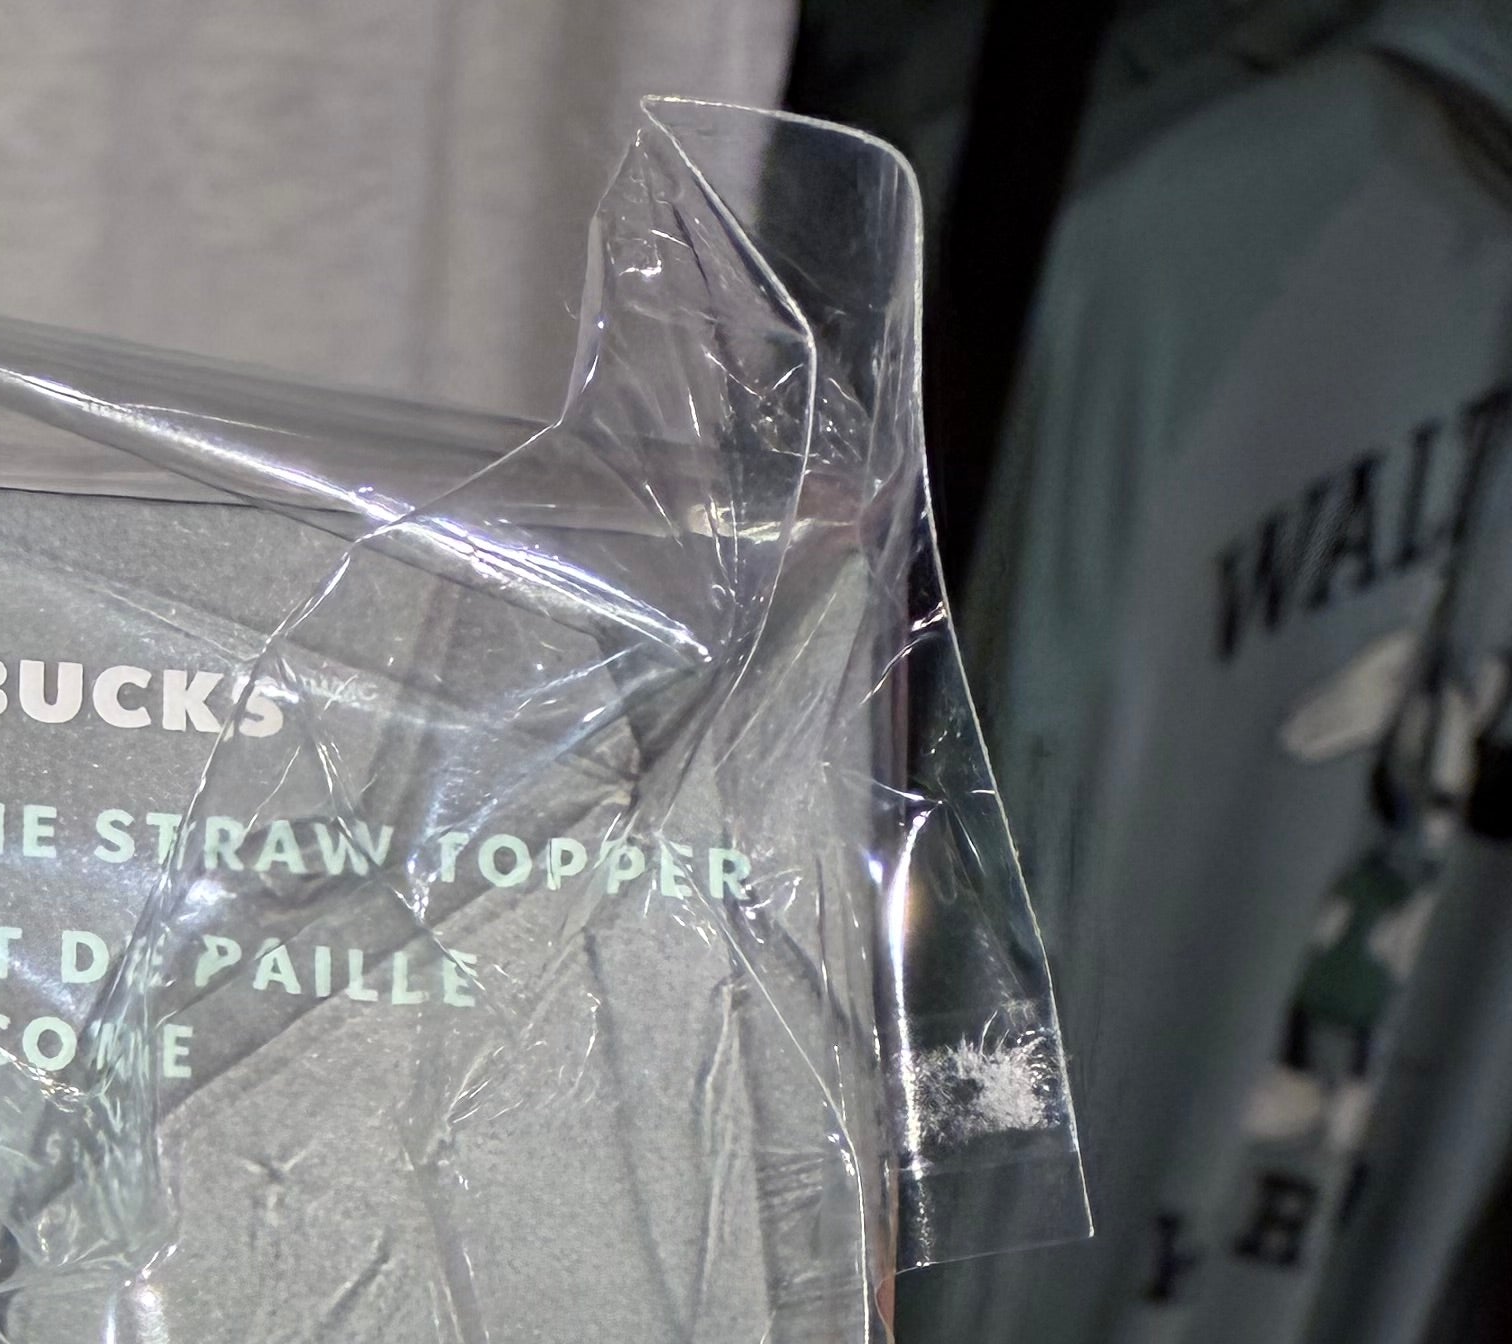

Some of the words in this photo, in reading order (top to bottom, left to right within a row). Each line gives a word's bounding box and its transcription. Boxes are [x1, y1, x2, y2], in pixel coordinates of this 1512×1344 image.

[93, 807, 395, 878] STRAW
[434, 831, 753, 900] TOPPER
[194, 933, 478, 1008] PAILLE
